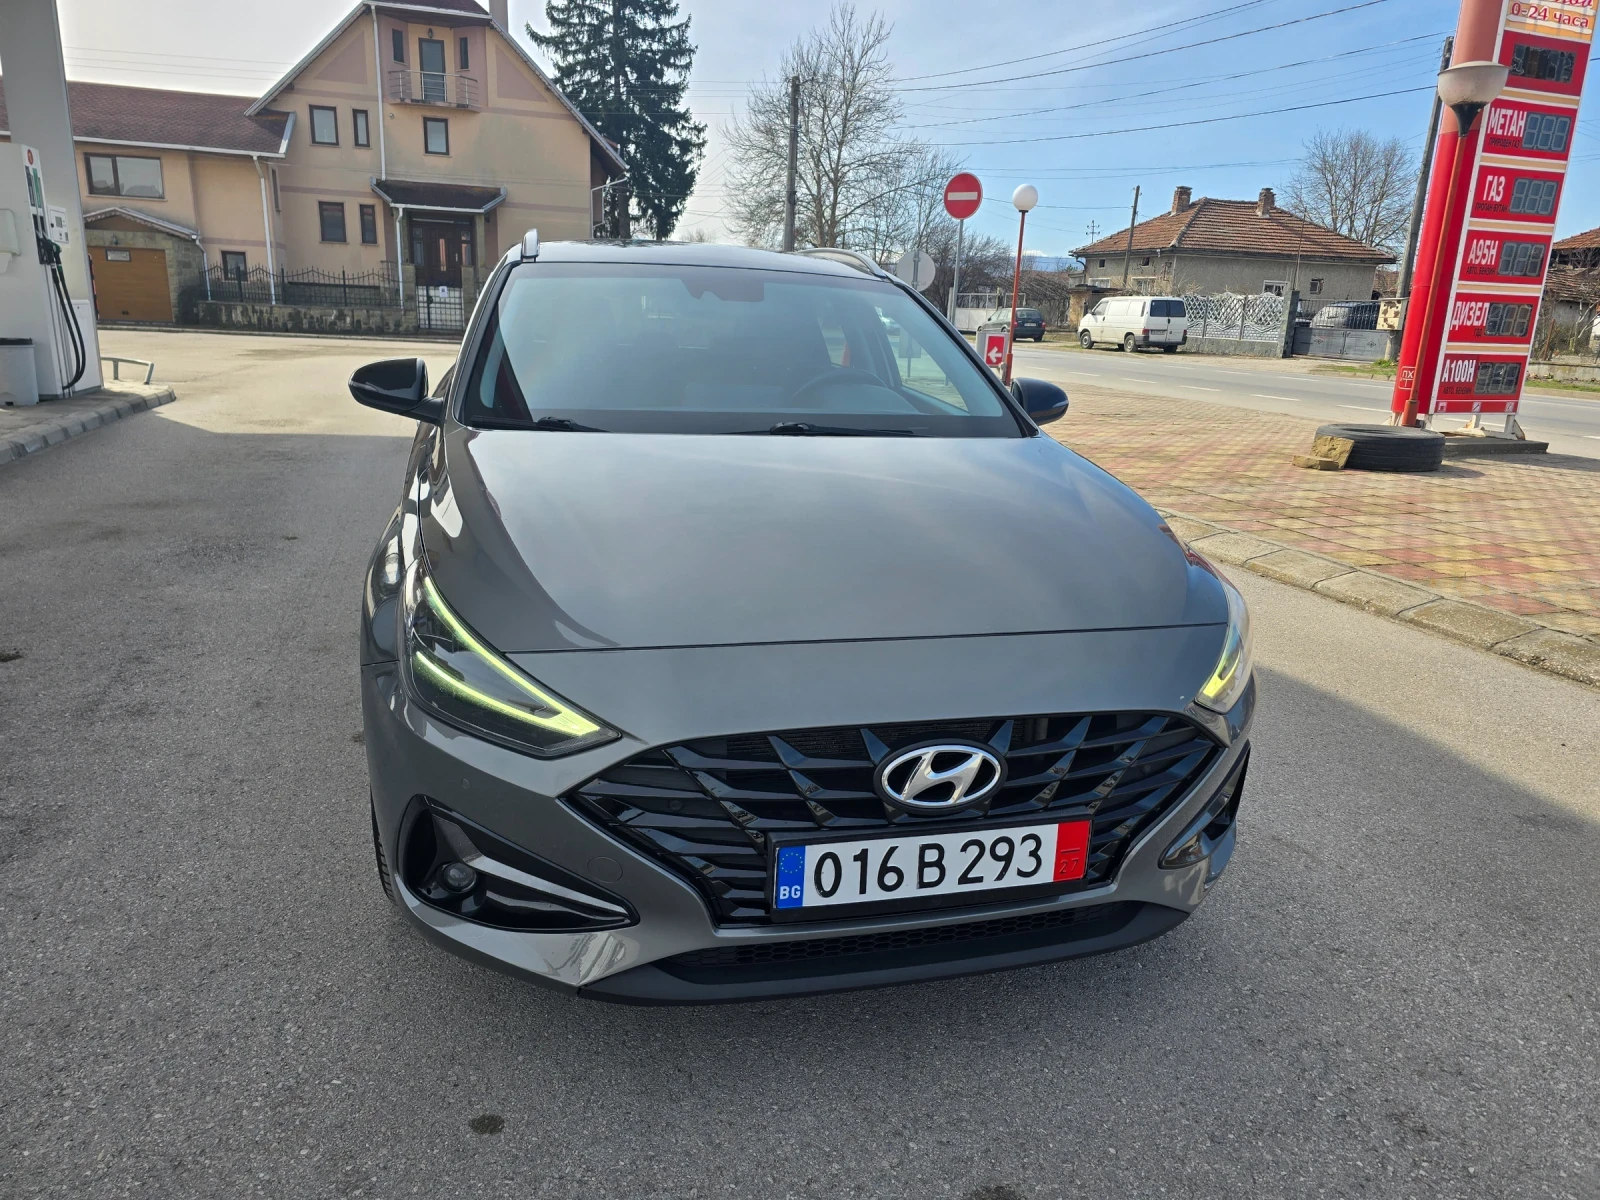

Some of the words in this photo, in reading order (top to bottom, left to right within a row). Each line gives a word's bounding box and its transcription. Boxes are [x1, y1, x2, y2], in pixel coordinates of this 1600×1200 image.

[1511, 2, 1549, 21] 0-24
[1553, 11, 1589, 28] часа
[1487, 107, 1527, 137] МЕТАН
[1483, 175, 1506, 202] ГАЗ
[1450, 301, 1490, 330] ДИЗЕЛ
[813, 846, 905, 899] 016
[957, 833, 1043, 885] 293
[779, 885, 801, 900] BG
